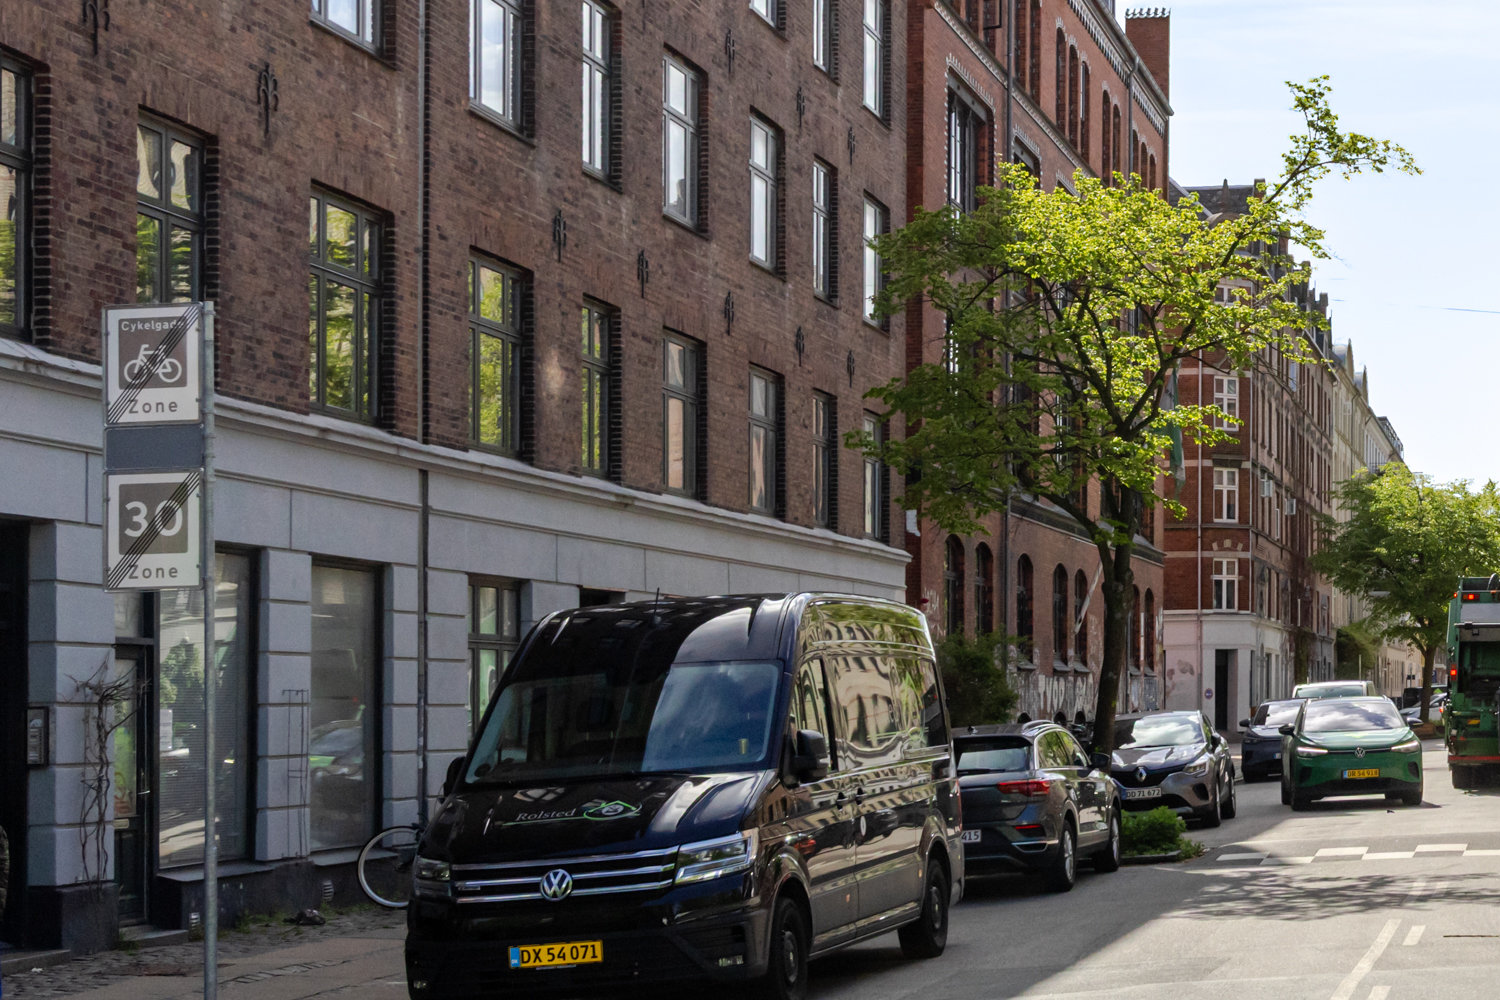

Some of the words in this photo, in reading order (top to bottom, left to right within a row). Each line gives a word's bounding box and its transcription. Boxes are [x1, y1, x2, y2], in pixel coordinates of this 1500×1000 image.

[121, 319, 185, 333] Cykelgad
[129, 399, 178, 414] Zone
[124, 500, 183, 538] 30
[129, 564, 178, 579] Zone
[516, 808, 577, 820] Rolsted
[961, 831, 980, 841] 415
[521, 948, 542, 964] DX
[547, 946, 566, 962] 54
[570, 944, 598, 960] 071
